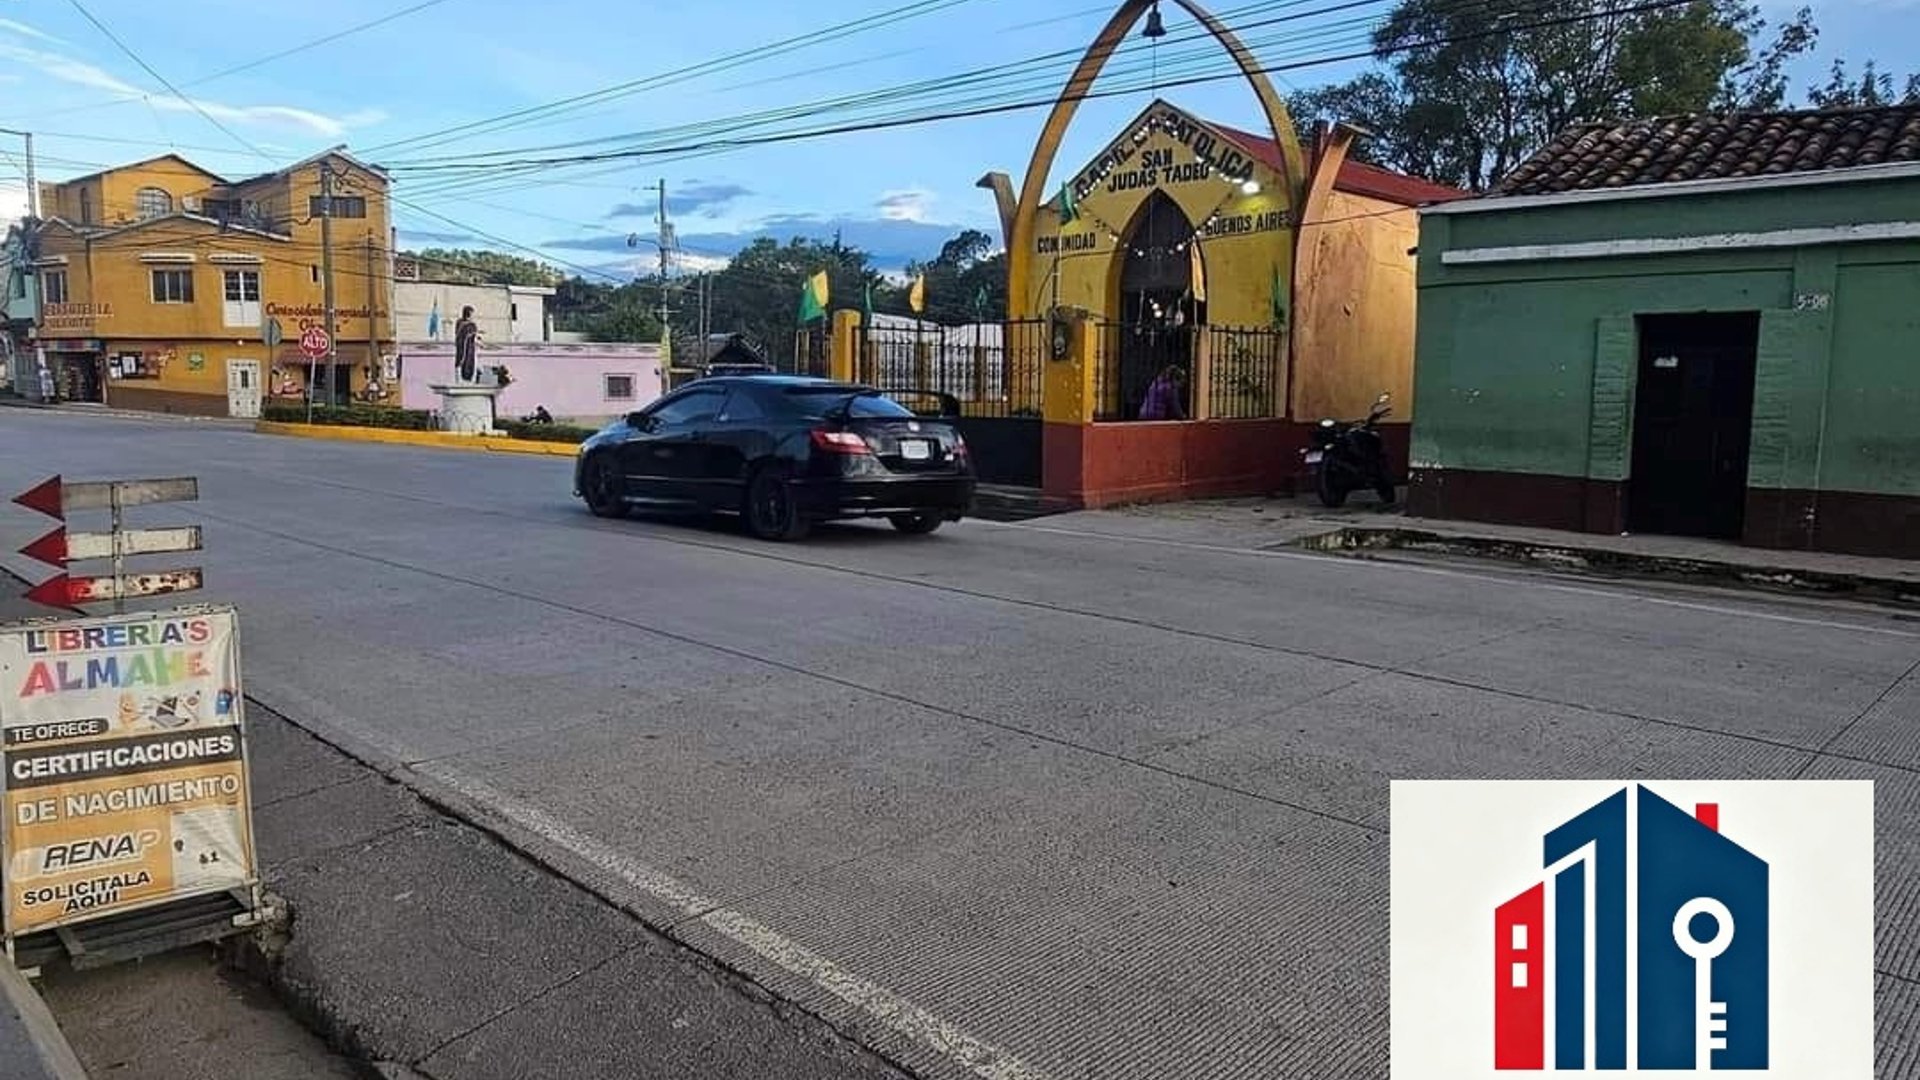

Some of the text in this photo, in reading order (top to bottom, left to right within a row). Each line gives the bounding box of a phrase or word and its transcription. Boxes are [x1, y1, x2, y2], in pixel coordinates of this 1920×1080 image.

[1142, 148, 1173, 169] SAN
[1107, 162, 1210, 192] JUDAS TADEO
[1205, 214, 1253, 235] BUENOS
[1037, 232, 1096, 253] COMUNIDAD
[303, 335, 328, 349] ALTO
[13, 721, 99, 742] TE OFRECE
[12, 735, 235, 779] CERTIFICACIONES
[16, 774, 240, 825] DE NACIMIENTO
[23, 871, 150, 905] SOLICITALA
[65, 890, 118, 912] AQUI
